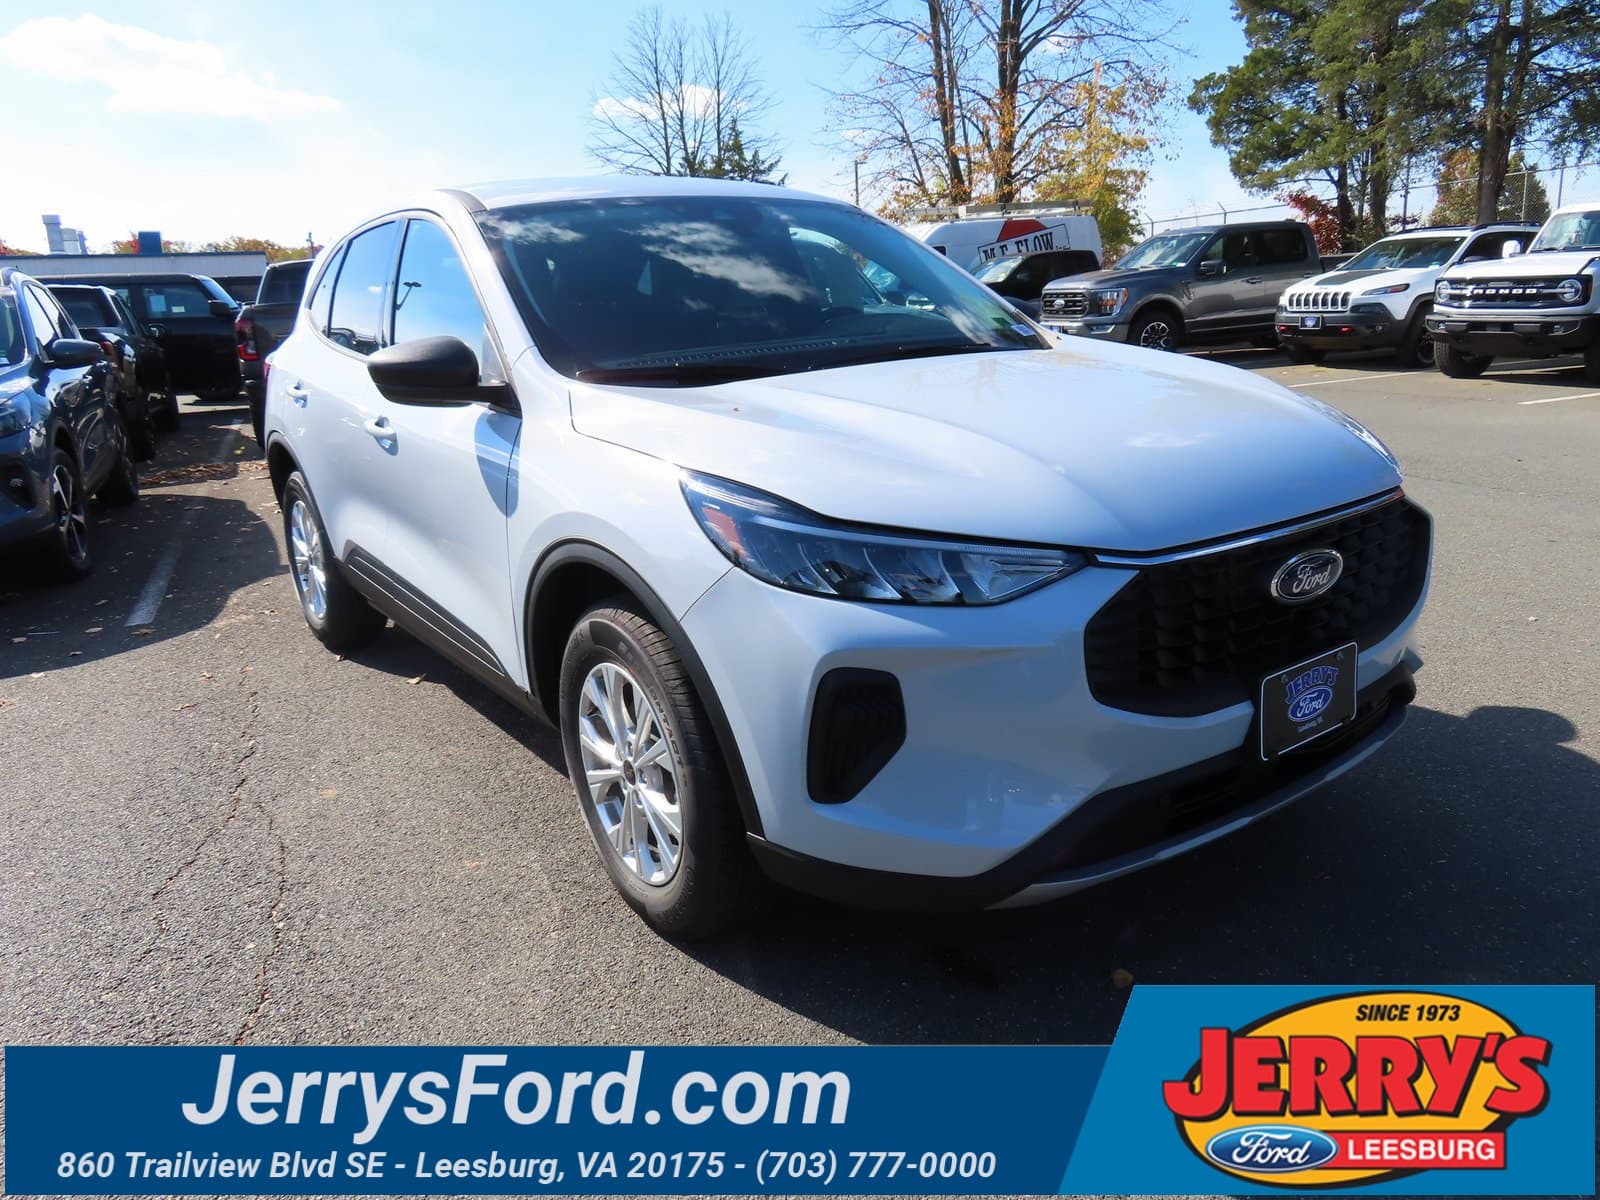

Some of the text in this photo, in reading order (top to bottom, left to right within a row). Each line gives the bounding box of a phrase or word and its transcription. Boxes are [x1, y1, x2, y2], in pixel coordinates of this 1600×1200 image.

[1292, 560, 1331, 593] Ford
[1284, 665, 1339, 705] JERRY'S
[1296, 691, 1325, 718] Ford
